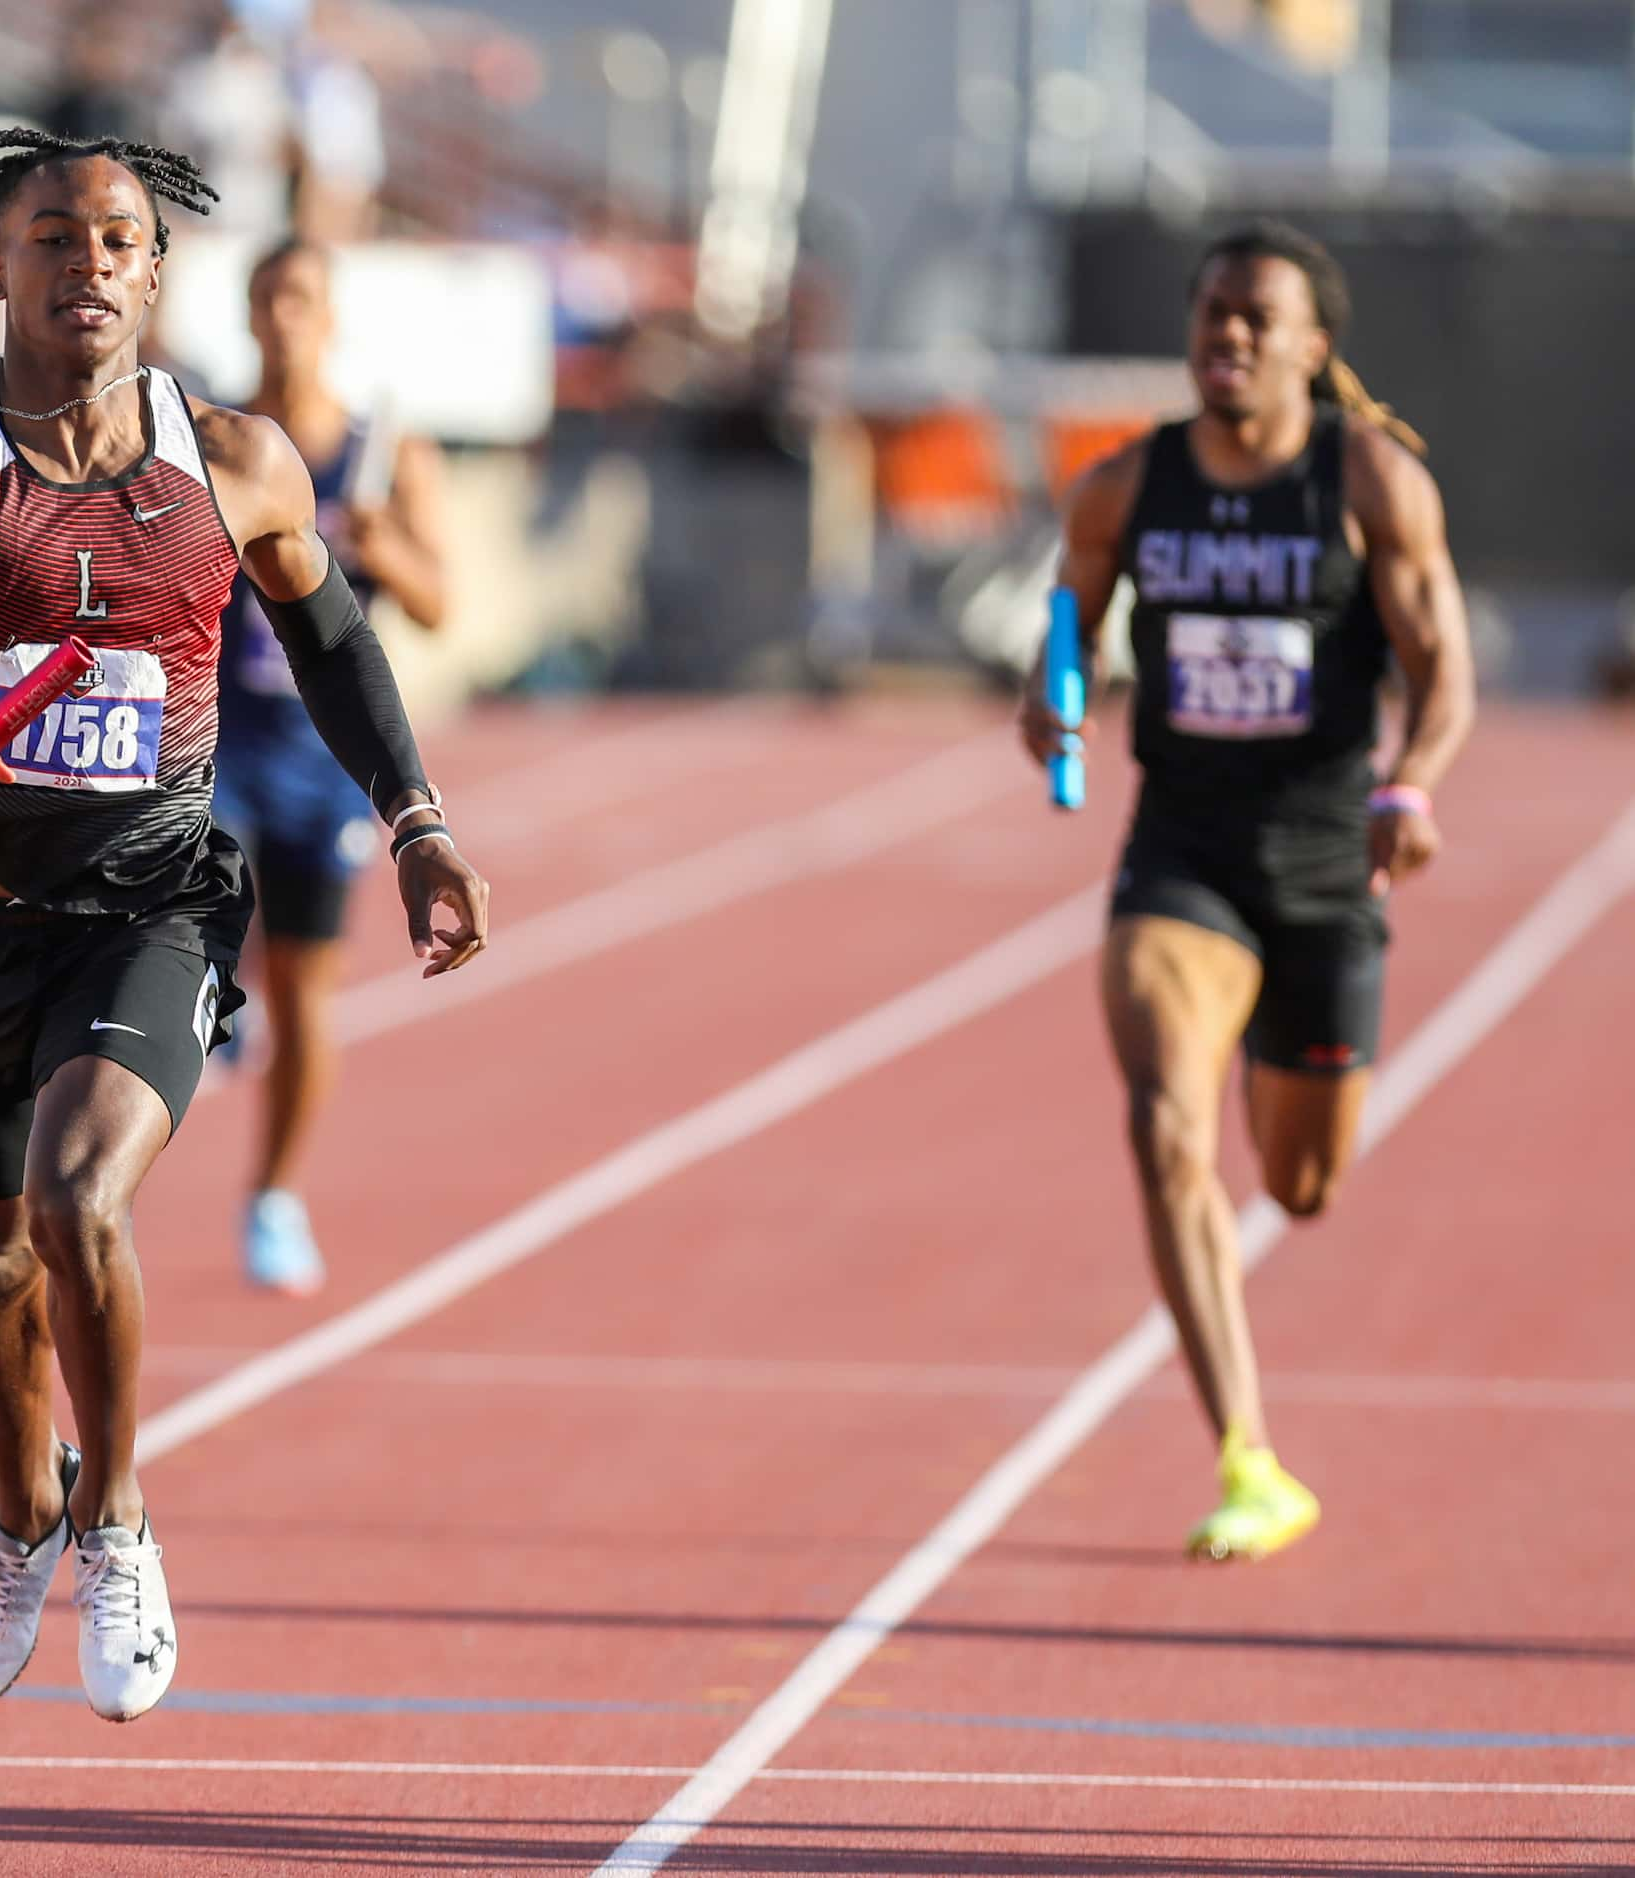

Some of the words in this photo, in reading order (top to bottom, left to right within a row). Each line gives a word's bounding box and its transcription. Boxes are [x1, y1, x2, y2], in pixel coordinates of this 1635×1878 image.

[75, 550, 107, 617] L
[1140, 532, 1320, 600] SUMMIT
[53, 776, 83, 787] 2021
